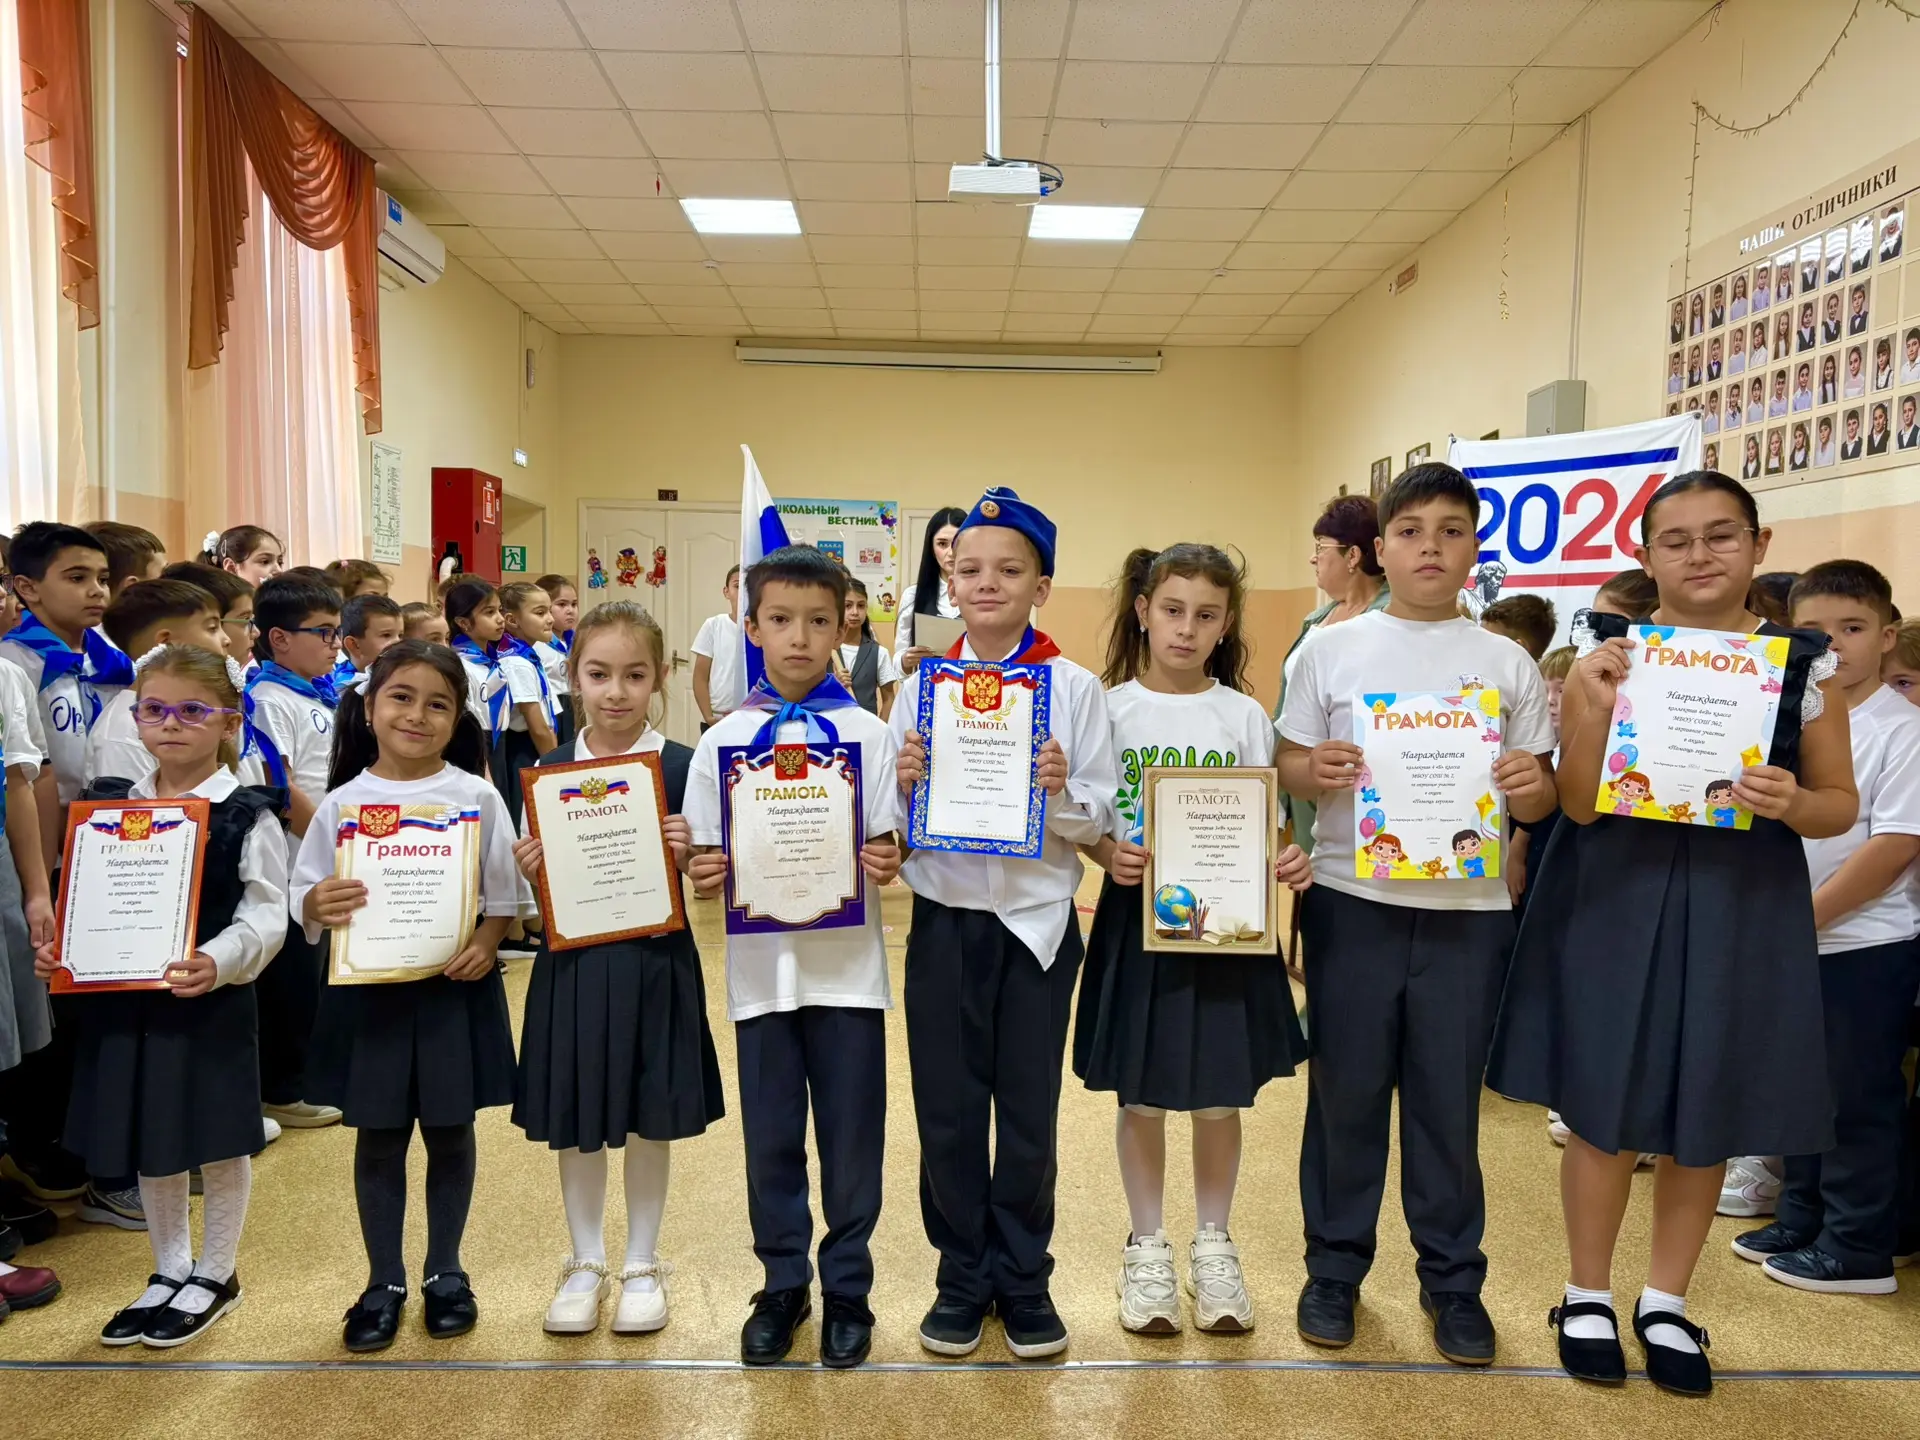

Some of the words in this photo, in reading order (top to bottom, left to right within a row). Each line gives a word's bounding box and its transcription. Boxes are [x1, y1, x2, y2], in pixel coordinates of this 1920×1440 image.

[1740, 221, 1785, 256] НАШИ
[1792, 165, 1897, 230] ОТЛИЧНИКИ
[828, 516, 878, 526] ВЕСТНИК
[1645, 647, 1758, 675] ГРАМОТА
[1666, 690, 1738, 707] Награждается
[956, 720, 1008, 730] ГРАМОТА
[1374, 710, 1477, 730] ГРАМОТА
[957, 736, 1016, 747] Награждается
[1401, 749, 1465, 761] Награждается
[756, 786, 828, 801] ГРАМОТА
[1178, 795, 1240, 804] ГРАМОТА
[567, 804, 628, 820] ГРАМОТА
[767, 805, 829, 817] Награждается
[1186, 811, 1246, 822] Награждается
[577, 828, 637, 843] Награждается
[101, 844, 164, 854] ГРАМОТА
[366, 841, 452, 860] Грамота
[106, 857, 169, 869] Награждается
[382, 867, 444, 878] Награждается
